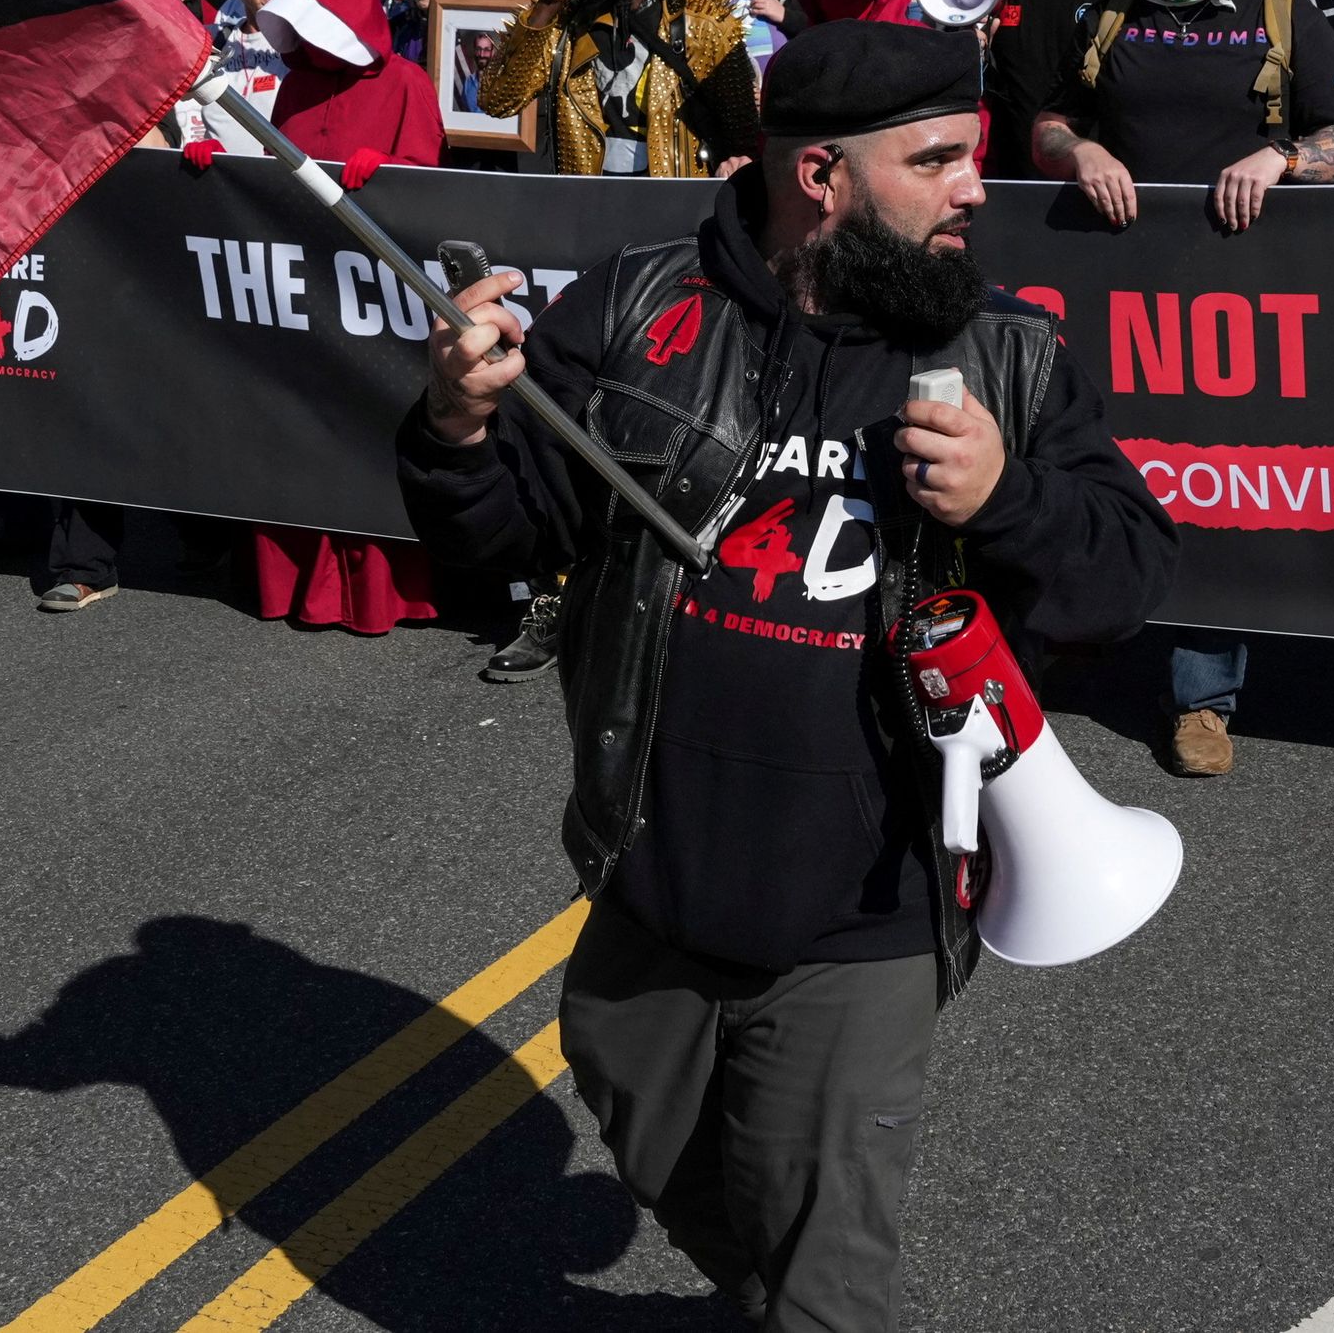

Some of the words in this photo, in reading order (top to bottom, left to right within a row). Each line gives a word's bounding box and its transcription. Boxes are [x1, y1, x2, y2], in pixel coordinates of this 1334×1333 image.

[1125, 26, 1266, 46] REEDUMB
[3, 254, 45, 282] RE
[682, 277, 713, 286] AIRB
[186, 235, 311, 331] THE
[1109, 291, 1319, 398] NOT
[704, 609, 719, 624] 4
[723, 612, 866, 650] DEMOCRACY
